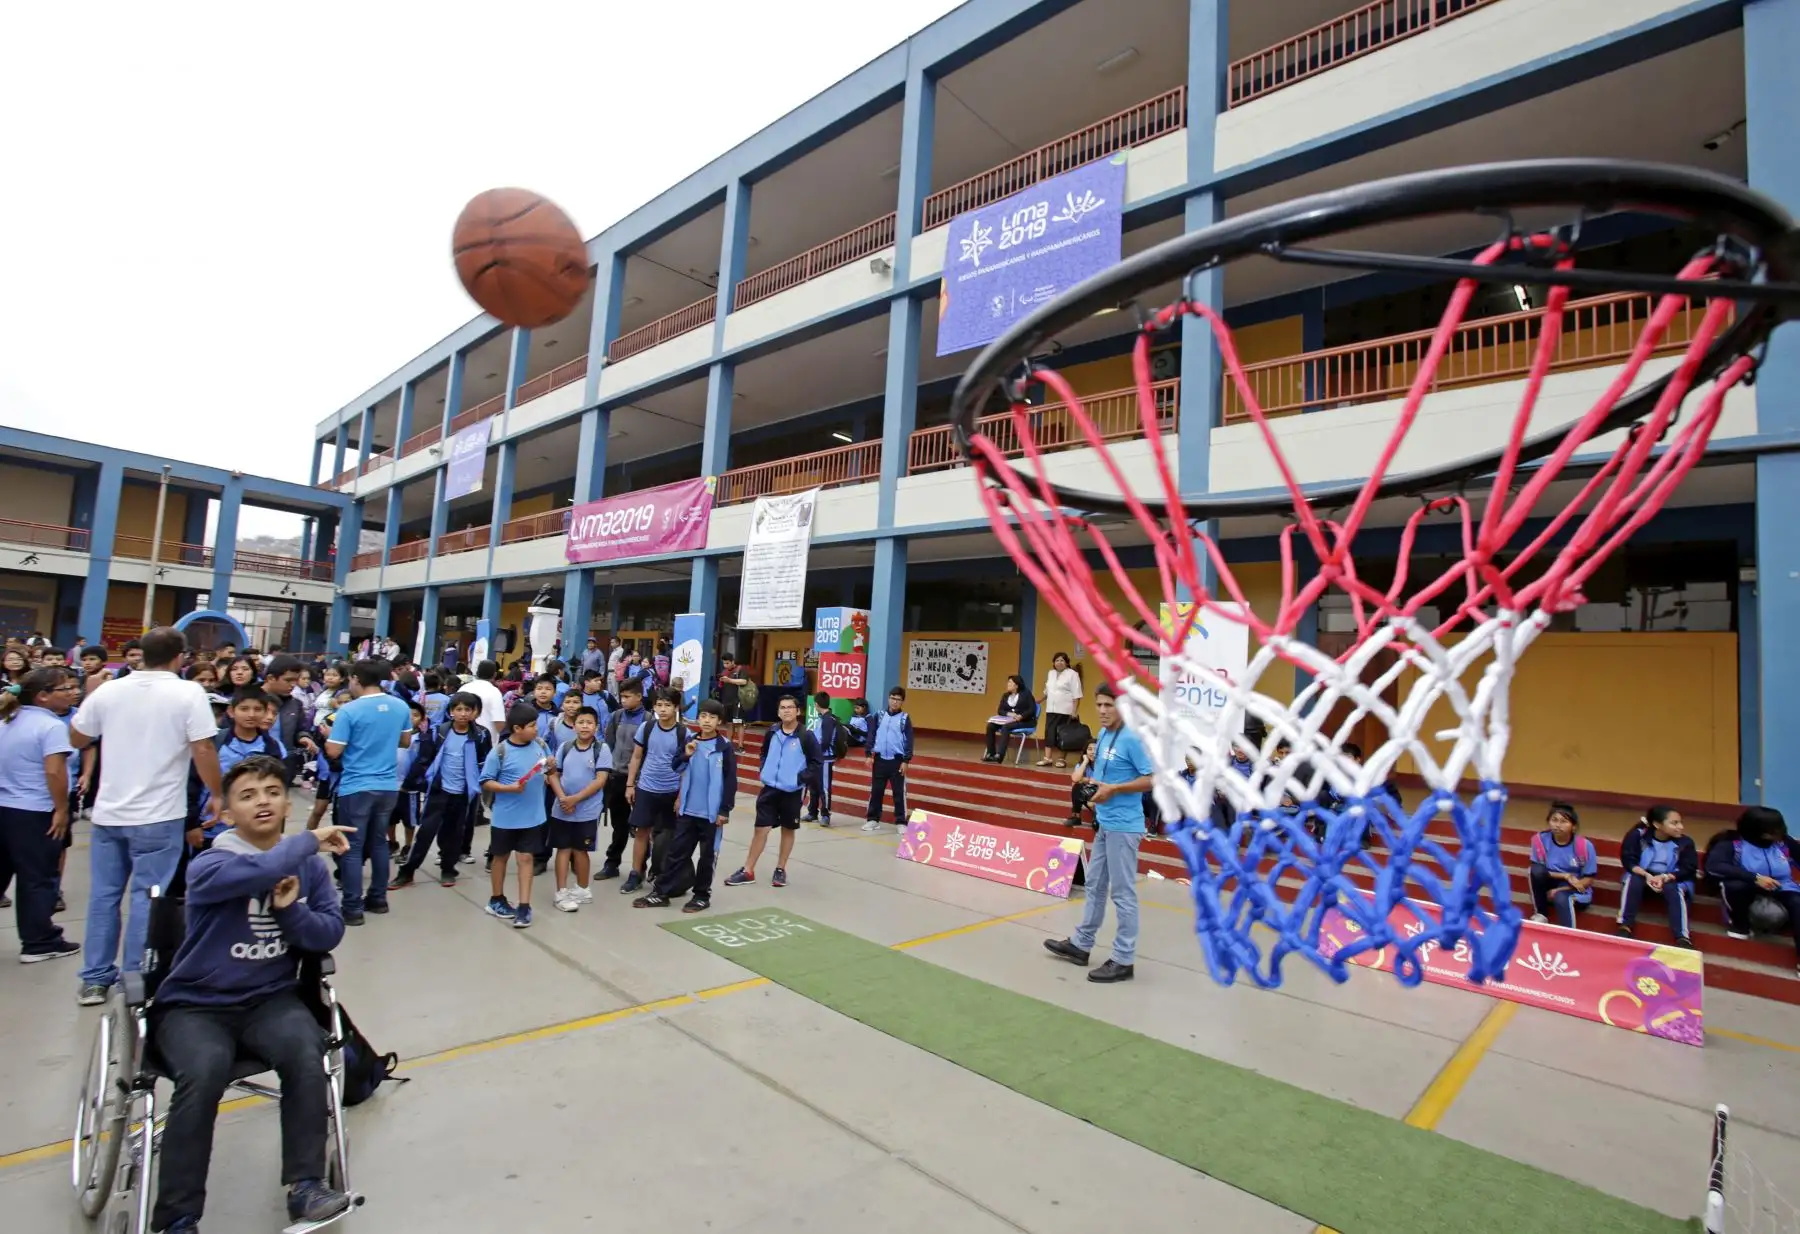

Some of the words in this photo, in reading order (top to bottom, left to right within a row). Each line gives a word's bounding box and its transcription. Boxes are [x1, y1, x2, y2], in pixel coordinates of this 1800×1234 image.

[998, 219, 1047, 250] 2019
[817, 629, 839, 643] 2019
[822, 674, 861, 689] 2019
[966, 844, 994, 860] 2019
[230, 938, 289, 960] adida
